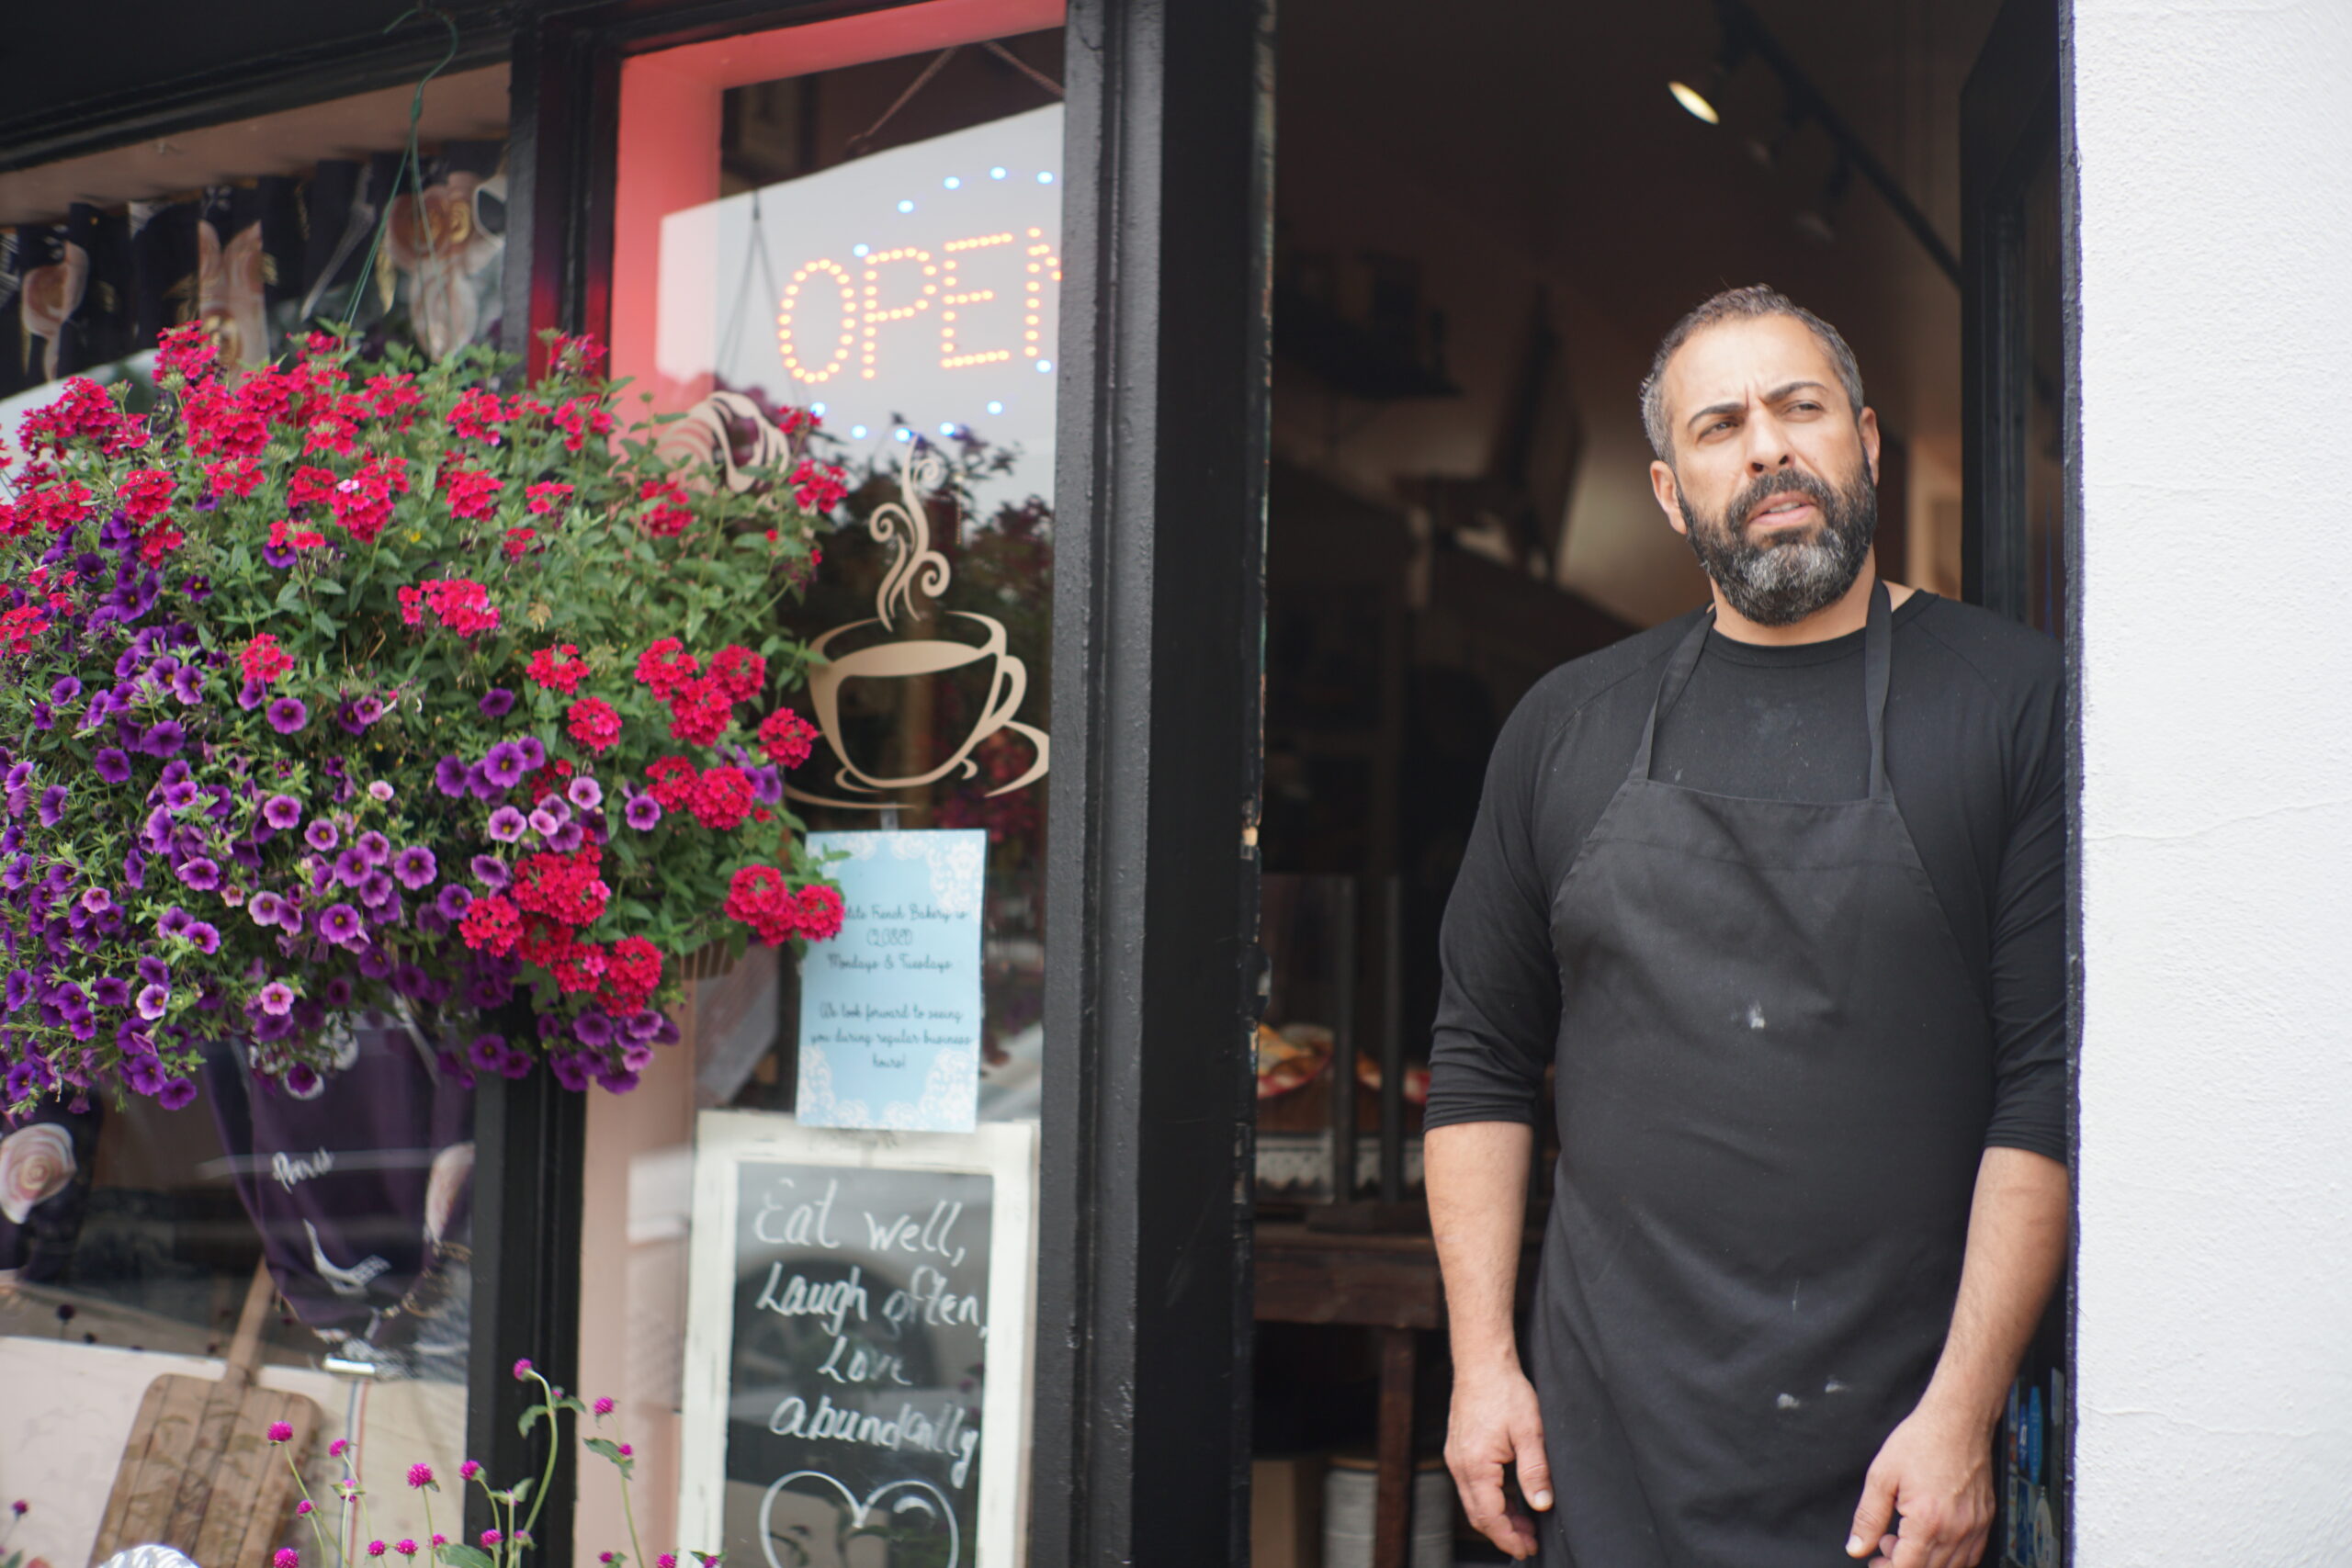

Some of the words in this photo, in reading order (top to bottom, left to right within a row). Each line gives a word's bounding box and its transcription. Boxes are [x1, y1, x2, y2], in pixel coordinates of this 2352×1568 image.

[870, 903, 905, 919] French
[909, 903, 952, 923] Bakery
[866, 928, 913, 947] CLOSED
[827, 953, 878, 974] Mondays
[899, 953, 954, 974] Tuesdays
[820, 1000, 838, 1019] We
[842, 1002, 861, 1019] look
[865, 1003, 910, 1022] forward
[913, 1003, 924, 1019] to
[927, 1008, 963, 1024] seeing
[810, 1032, 831, 1045] you
[835, 1027, 871, 1047] during
[876, 1028, 919, 1047] regular
[923, 1028, 972, 1045] business
[752, 1179, 841, 1250] Eat
[864, 1200, 967, 1267] well,
[755, 1261, 868, 1337] Laugh
[818, 1335, 913, 1385] Love
